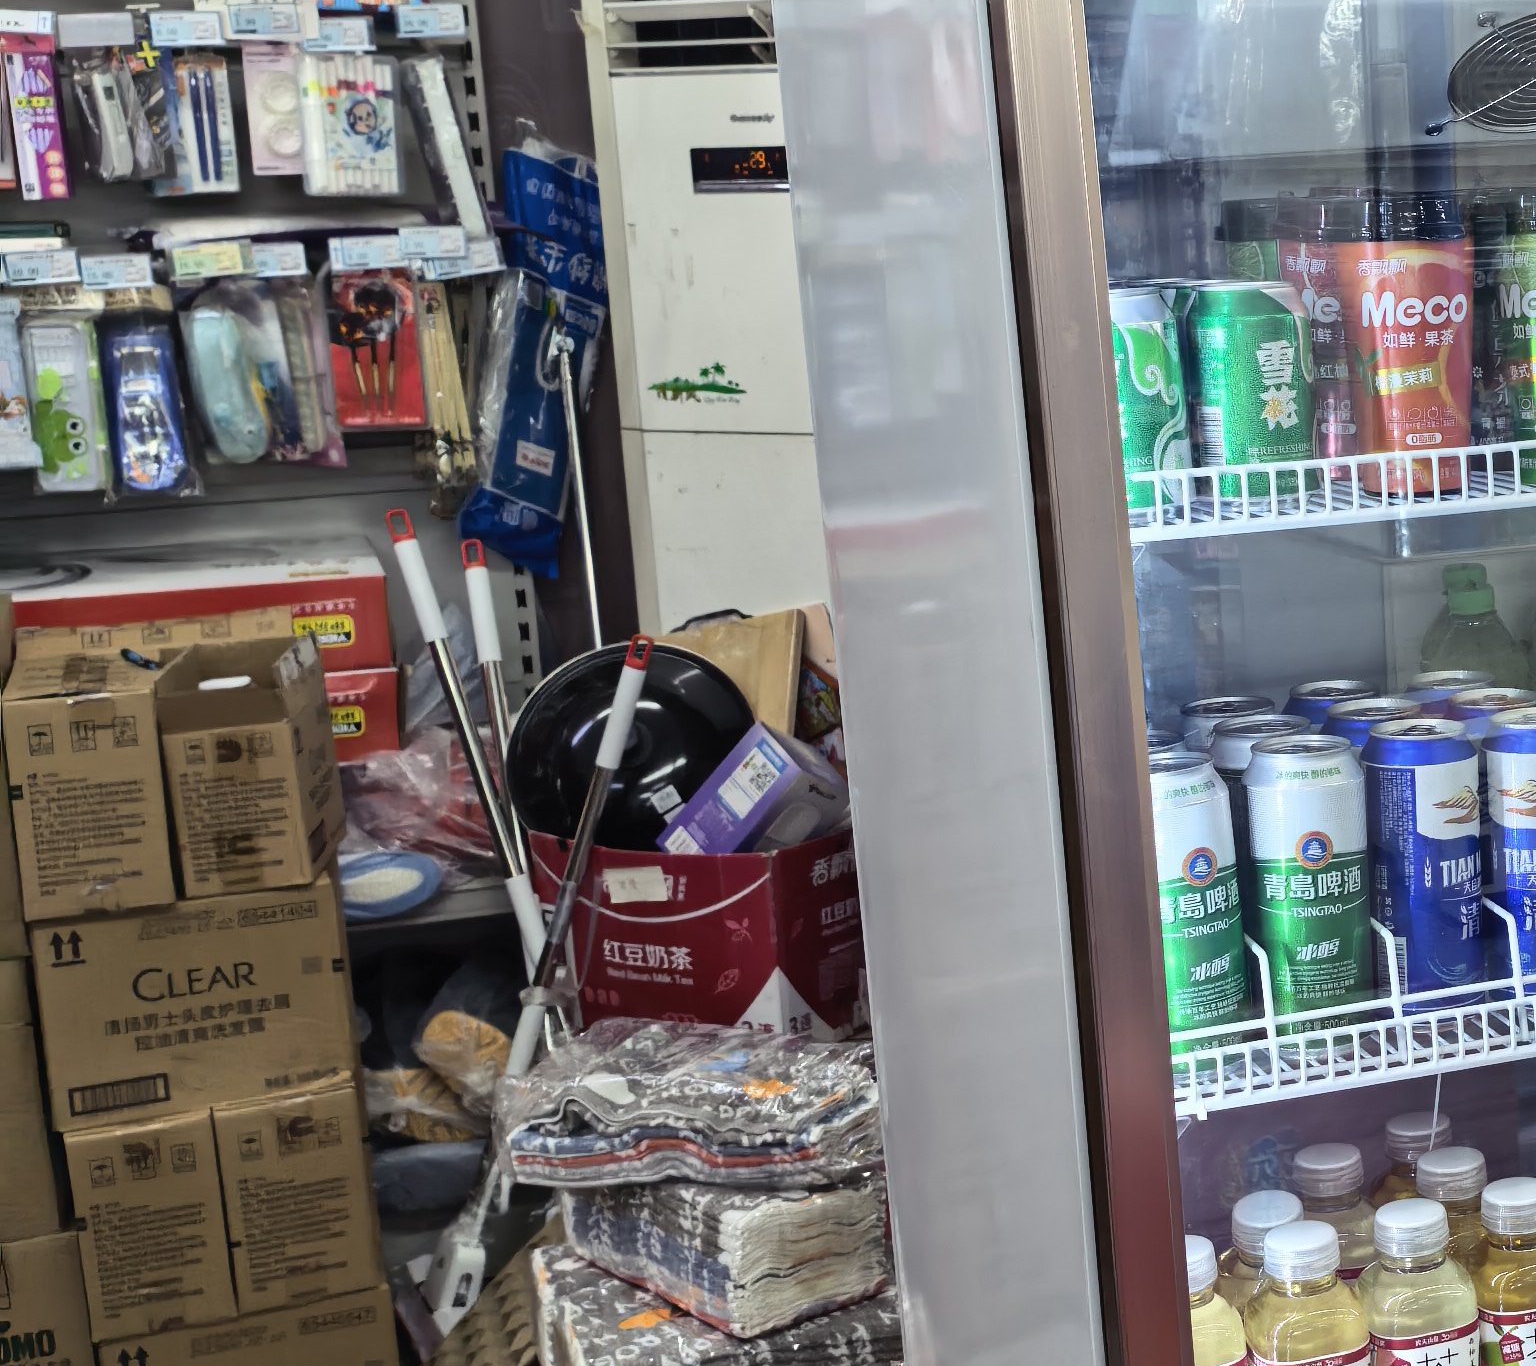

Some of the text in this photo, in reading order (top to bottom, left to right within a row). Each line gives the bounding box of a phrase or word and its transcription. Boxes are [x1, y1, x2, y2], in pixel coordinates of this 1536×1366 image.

[1357, 258, 1407, 276] 香飘飘
[1361, 290, 1468, 328] Meco
[1256, 340, 1299, 431] 雪花
[1263, 865, 1361, 902] 青岛啤酒
[1290, 904, 1343, 919] TSINGTAO
[1181, 921, 1230, 939] TSINGTAO
[603, 938, 694, 971] 红豆奶茶
[132, 962, 257, 1002] CLEAR
